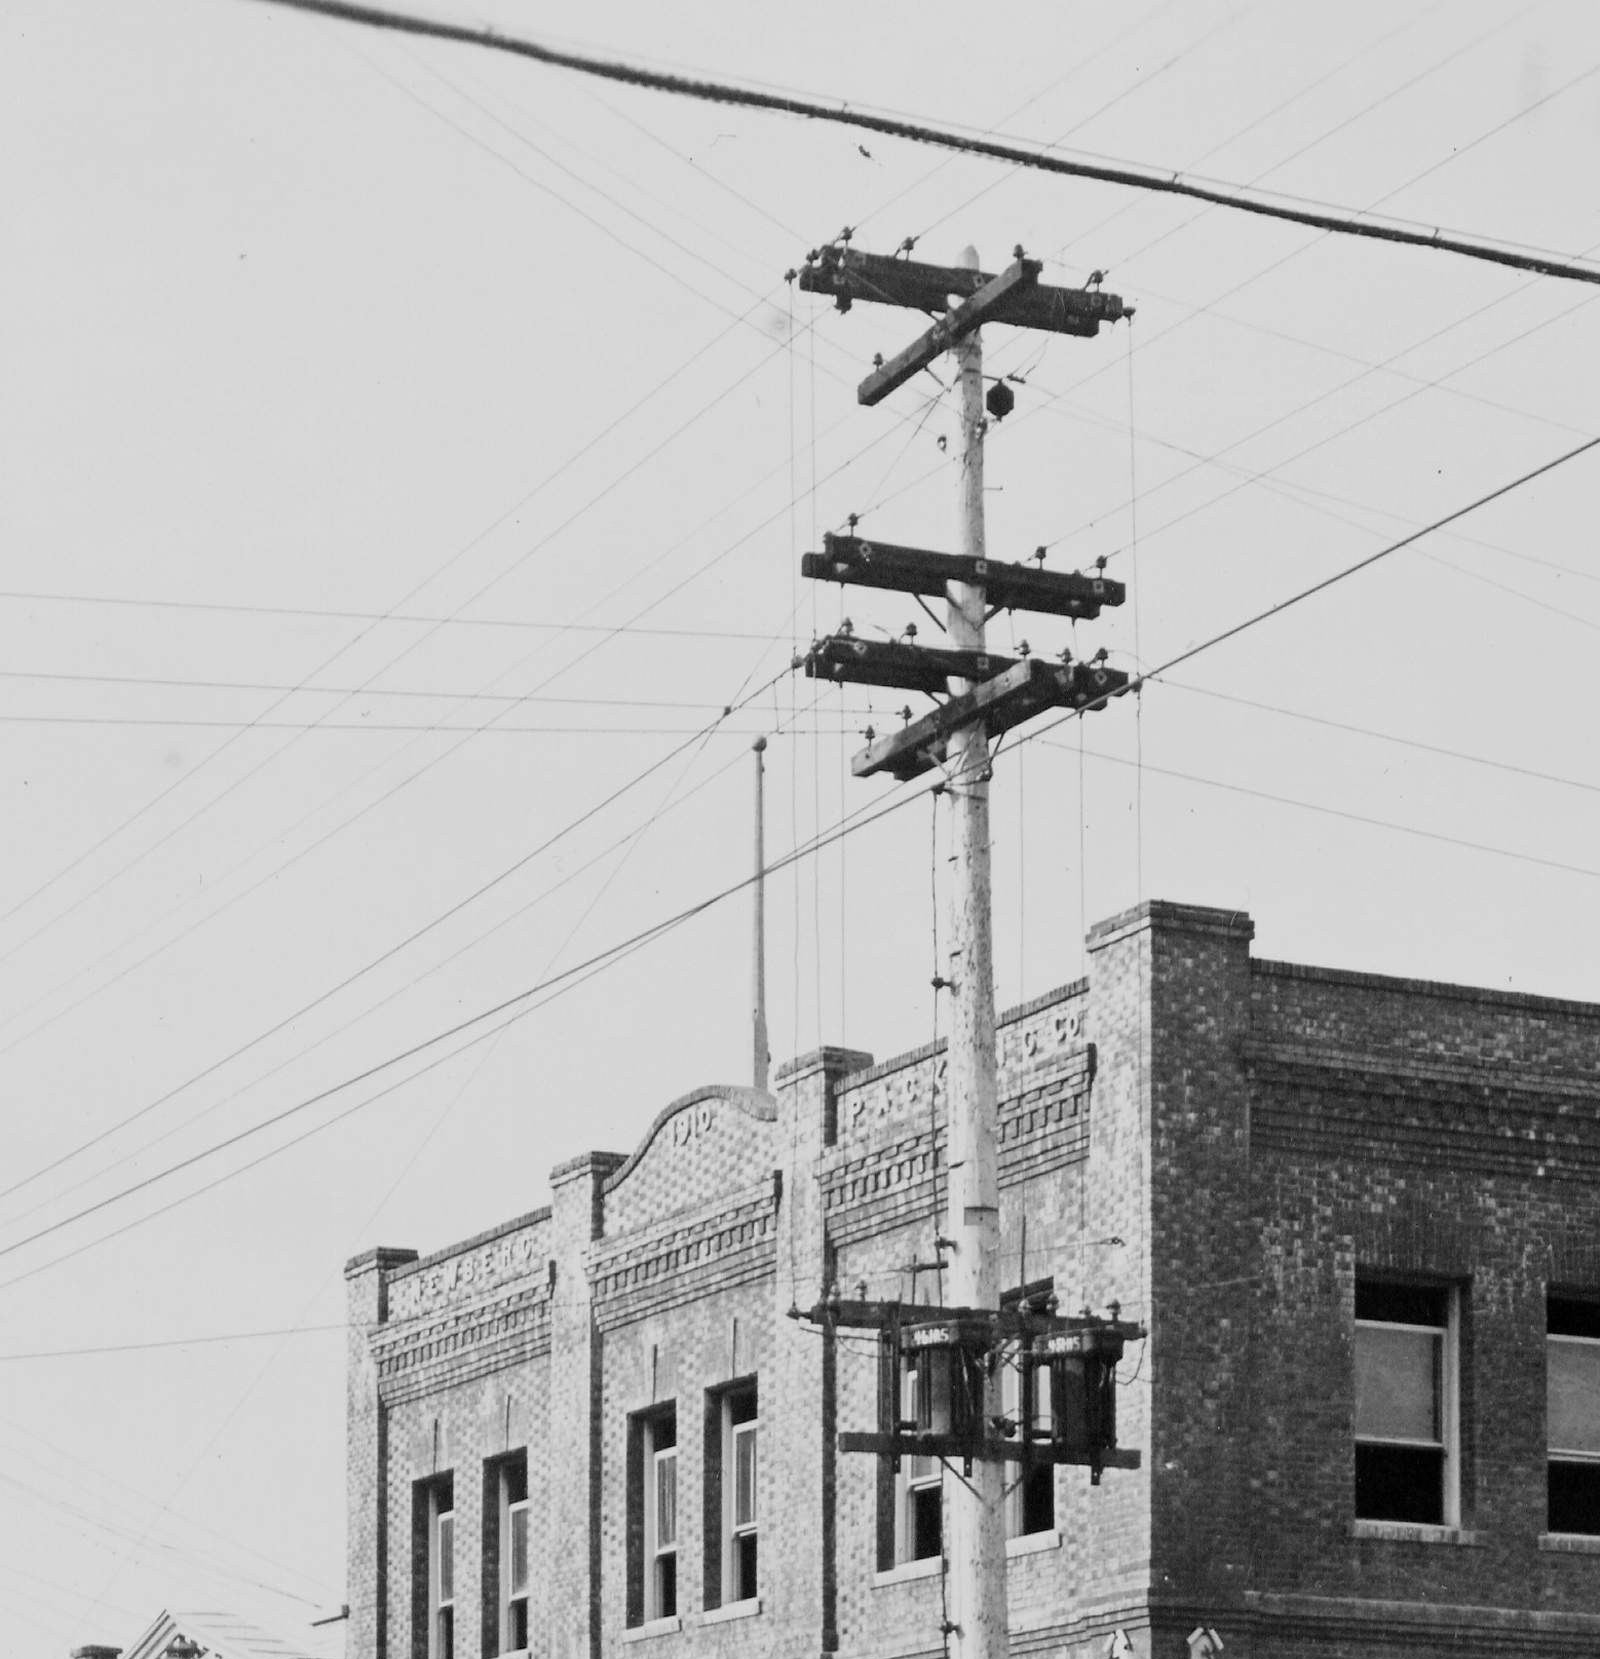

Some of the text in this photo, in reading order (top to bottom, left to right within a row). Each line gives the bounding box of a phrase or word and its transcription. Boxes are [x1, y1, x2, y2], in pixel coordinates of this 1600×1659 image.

[850, 1028, 1037, 1128] PACKG
[670, 1105, 711, 1147] 1910
[408, 1235, 532, 1305] NEWBERG
